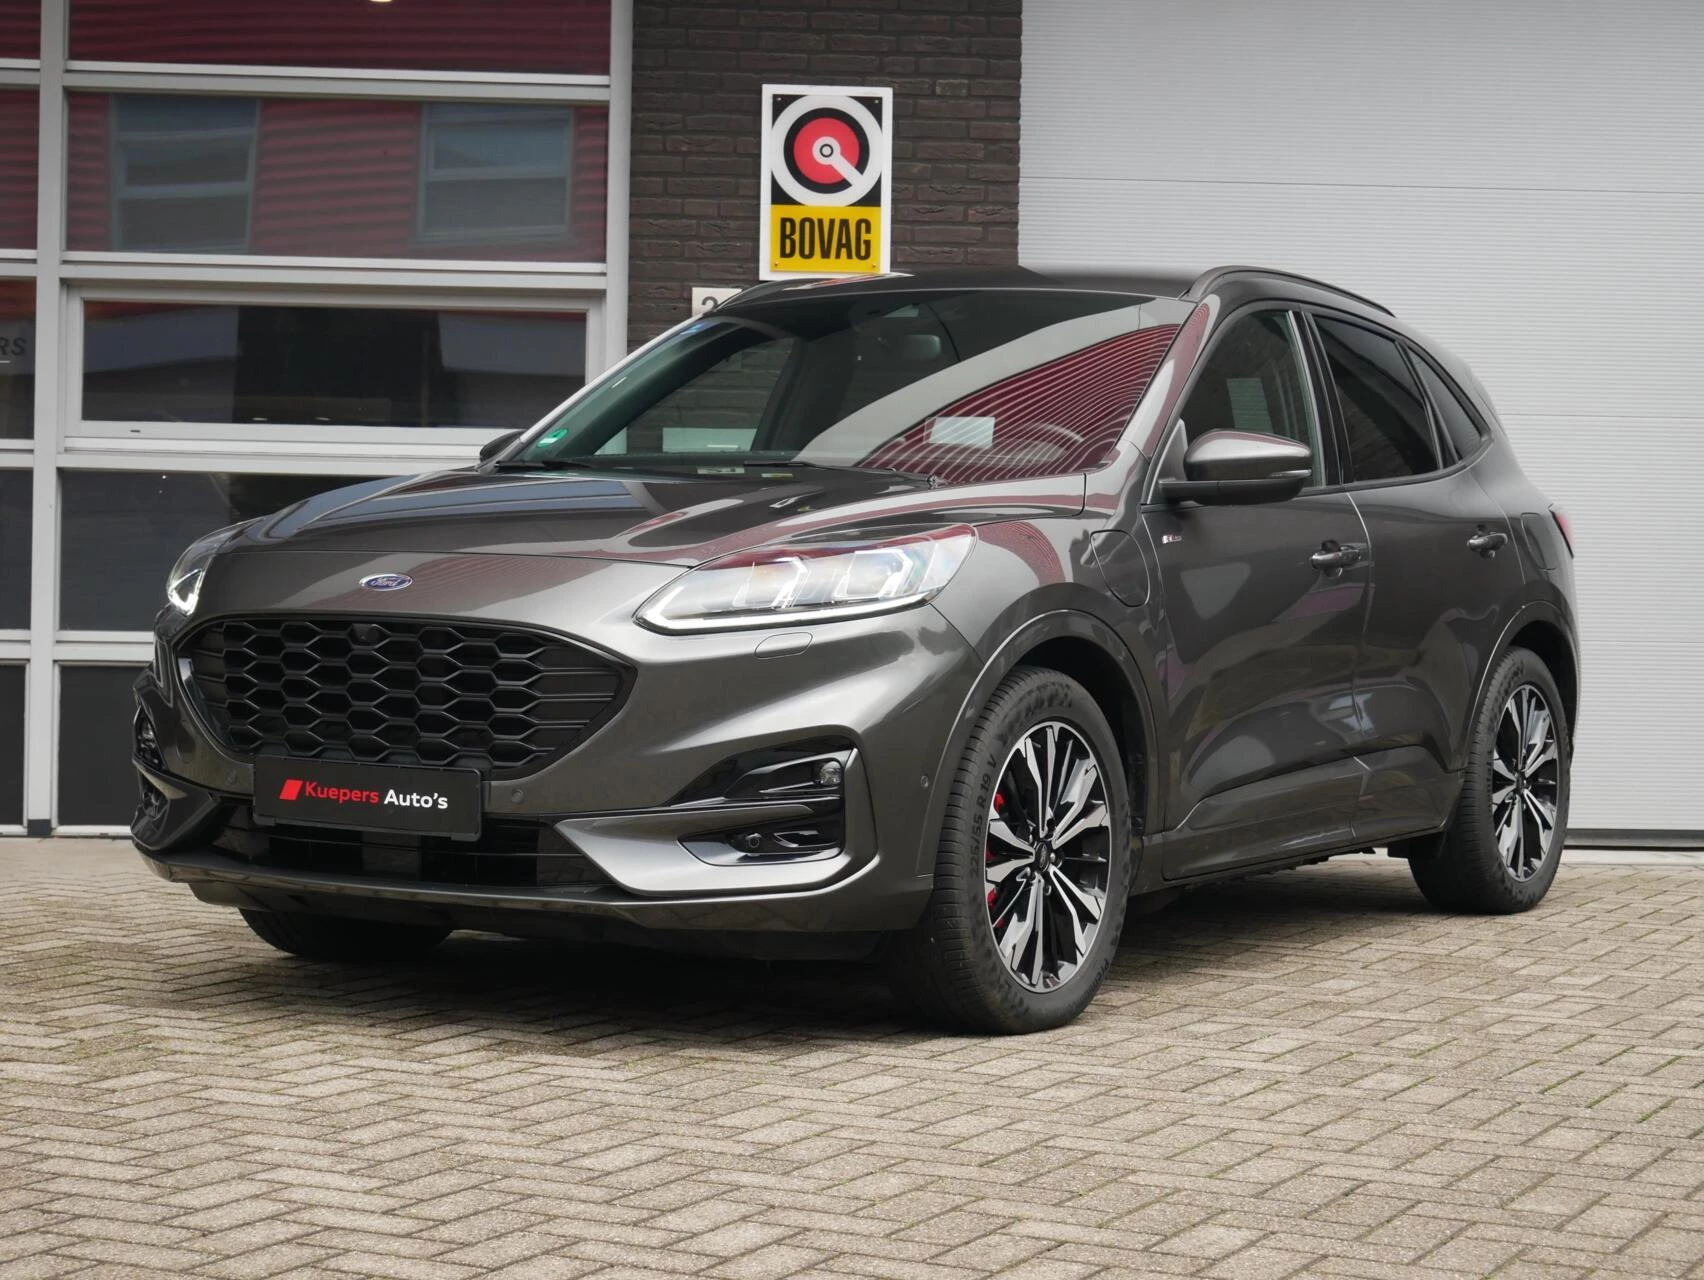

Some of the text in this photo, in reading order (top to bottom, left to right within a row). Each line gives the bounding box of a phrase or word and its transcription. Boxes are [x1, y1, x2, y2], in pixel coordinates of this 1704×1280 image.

[779, 217, 872, 261] BOVAG
[305, 781, 380, 804] Kuepers
[969, 753, 997, 880] 225/55 R 19 V
